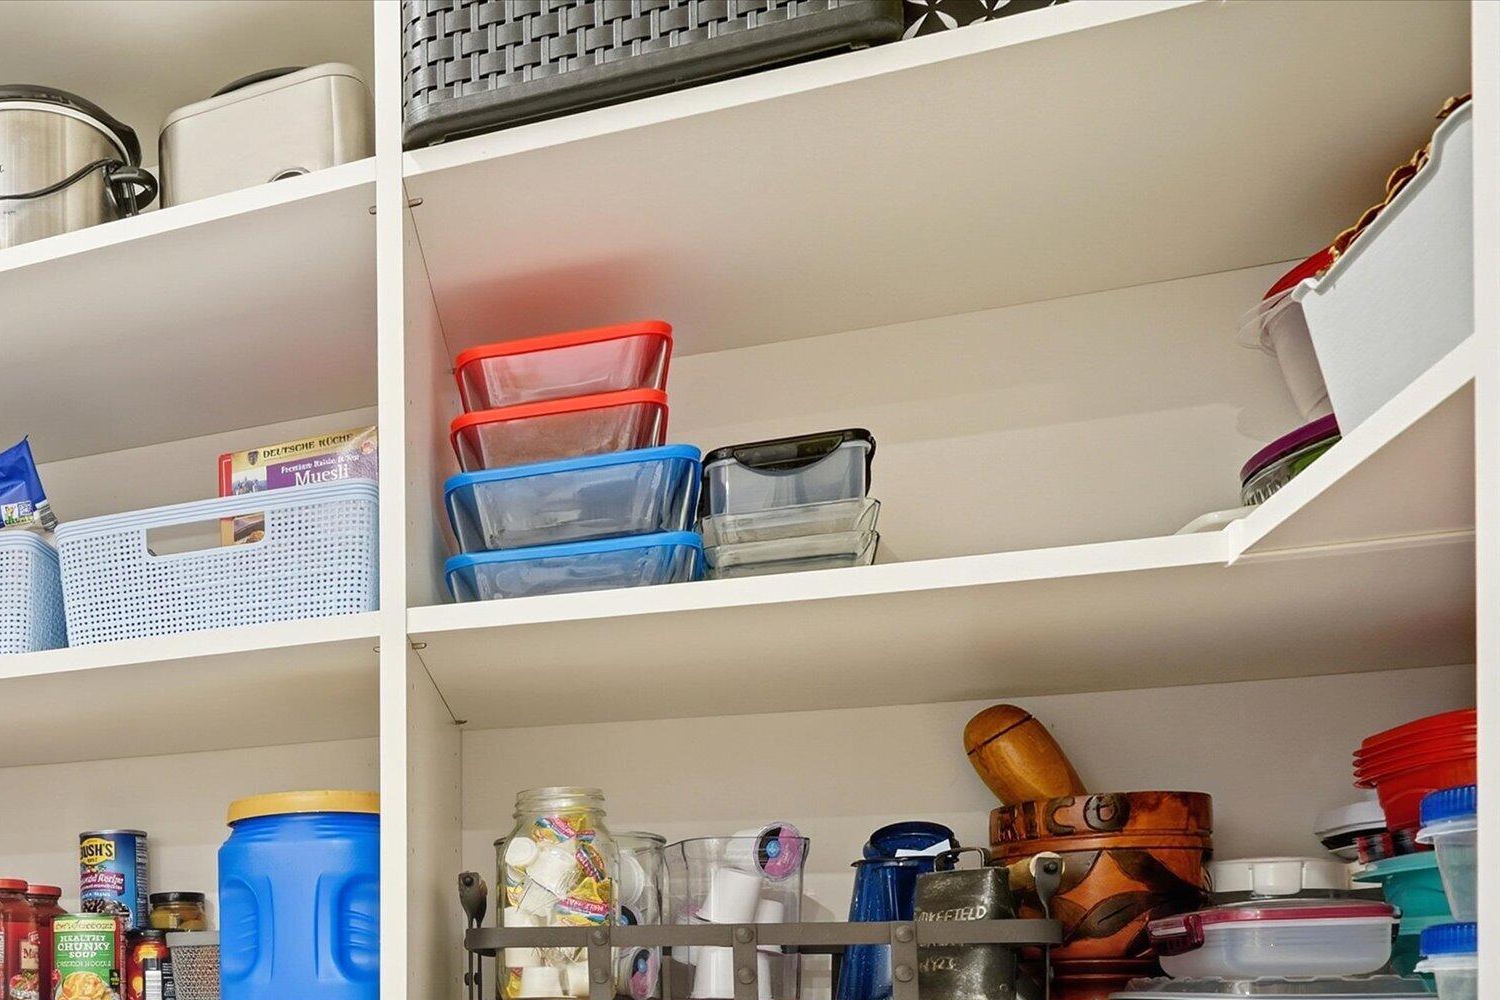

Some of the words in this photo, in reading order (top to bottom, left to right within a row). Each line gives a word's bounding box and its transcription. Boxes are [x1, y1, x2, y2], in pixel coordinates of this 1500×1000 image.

[263, 440, 315, 458] DEUTSCHE
[281, 462, 312, 474] Premium
[295, 464, 349, 486] Muesli
[80, 841, 113, 860] USH'S
[60, 934, 106, 942] HEALTHY
[57, 942, 110, 952] CHUNKY
[69, 951, 97, 959] SOUP
